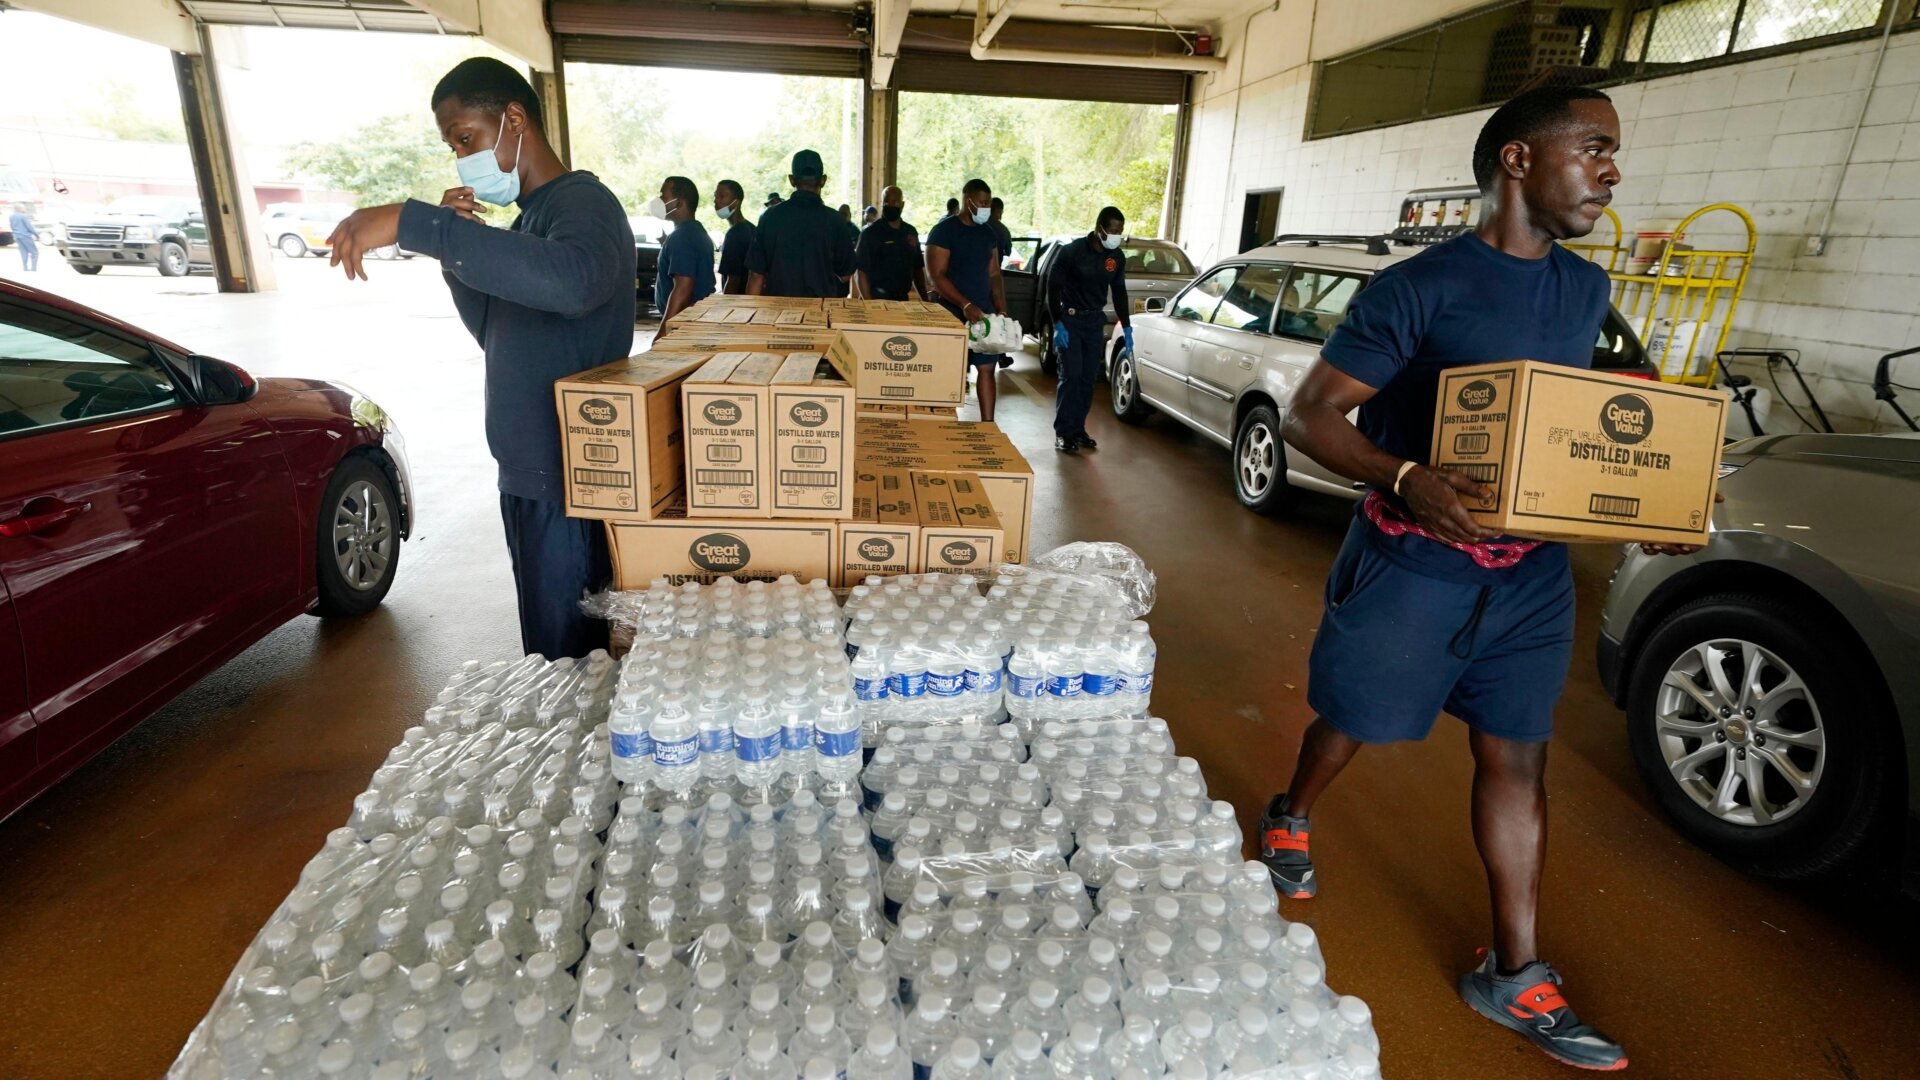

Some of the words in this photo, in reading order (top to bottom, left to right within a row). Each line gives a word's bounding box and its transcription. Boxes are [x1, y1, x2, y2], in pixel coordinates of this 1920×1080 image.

[886, 342, 912, 352] Great
[864, 362, 904, 372] DISTILLED
[906, 363, 932, 373] WATER
[1462, 388, 1490, 398] Great
[583, 404, 611, 415] Great
[708, 406, 735, 416] Great
[794, 407, 821, 417] Great
[1606, 403, 1646, 425] Great
[1444, 415, 1480, 424] DISTILLED
[1481, 413, 1506, 423] WATER
[569, 426, 605, 436] DISTILLED
[607, 429, 631, 438] WATER
[692, 428, 728, 436] DISTILLED
[778, 429, 814, 437] DISTILLED
[1615, 421, 1643, 435] Value
[1549, 427, 1574, 438] GREAT
[1578, 431, 1602, 442] VALUE
[1547, 436, 1563, 445] EXP
[1570, 442, 1630, 464] DISTILLED
[1634, 450, 1671, 470] WATER
[1600, 465, 1612, 474] 3-1
[1612, 466, 1638, 477] GALLON
[696, 542, 740, 557] Great
[862, 543, 888, 552] Great
[945, 547, 971, 556] Great
[708, 554, 740, 564] Value
[656, 741, 695, 753] Running
[657, 750, 678, 760] Man
